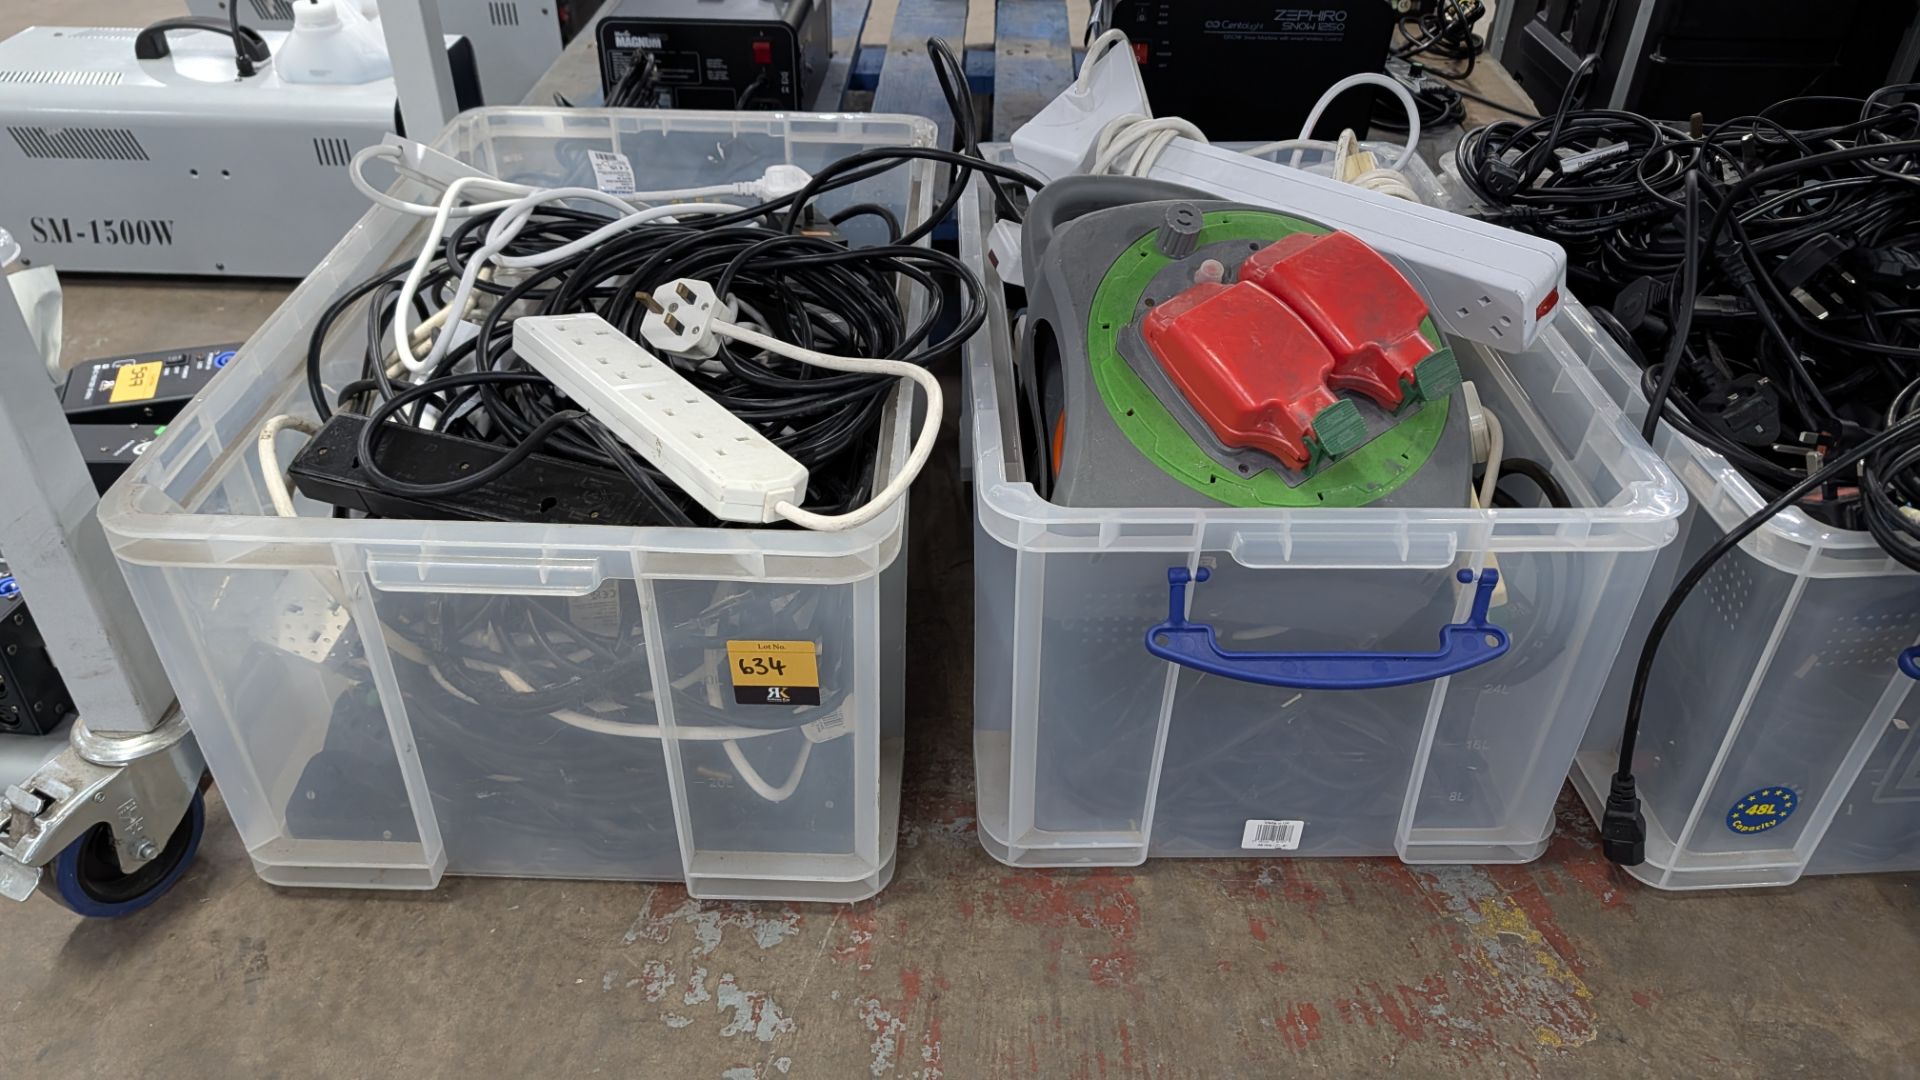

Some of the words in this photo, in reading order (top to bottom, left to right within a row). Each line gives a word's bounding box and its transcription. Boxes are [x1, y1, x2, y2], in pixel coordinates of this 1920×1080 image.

[1273, 9, 1347, 21] ZEPHIRO
[1282, 22, 1316, 31] SNOW
[615, 36, 662, 49] MAGNUM
[30, 216, 174, 246] SM-1500W
[739, 657, 786, 675] 634
[1745, 803, 1776, 815] 48L
[1732, 819, 1777, 832] Capacity
